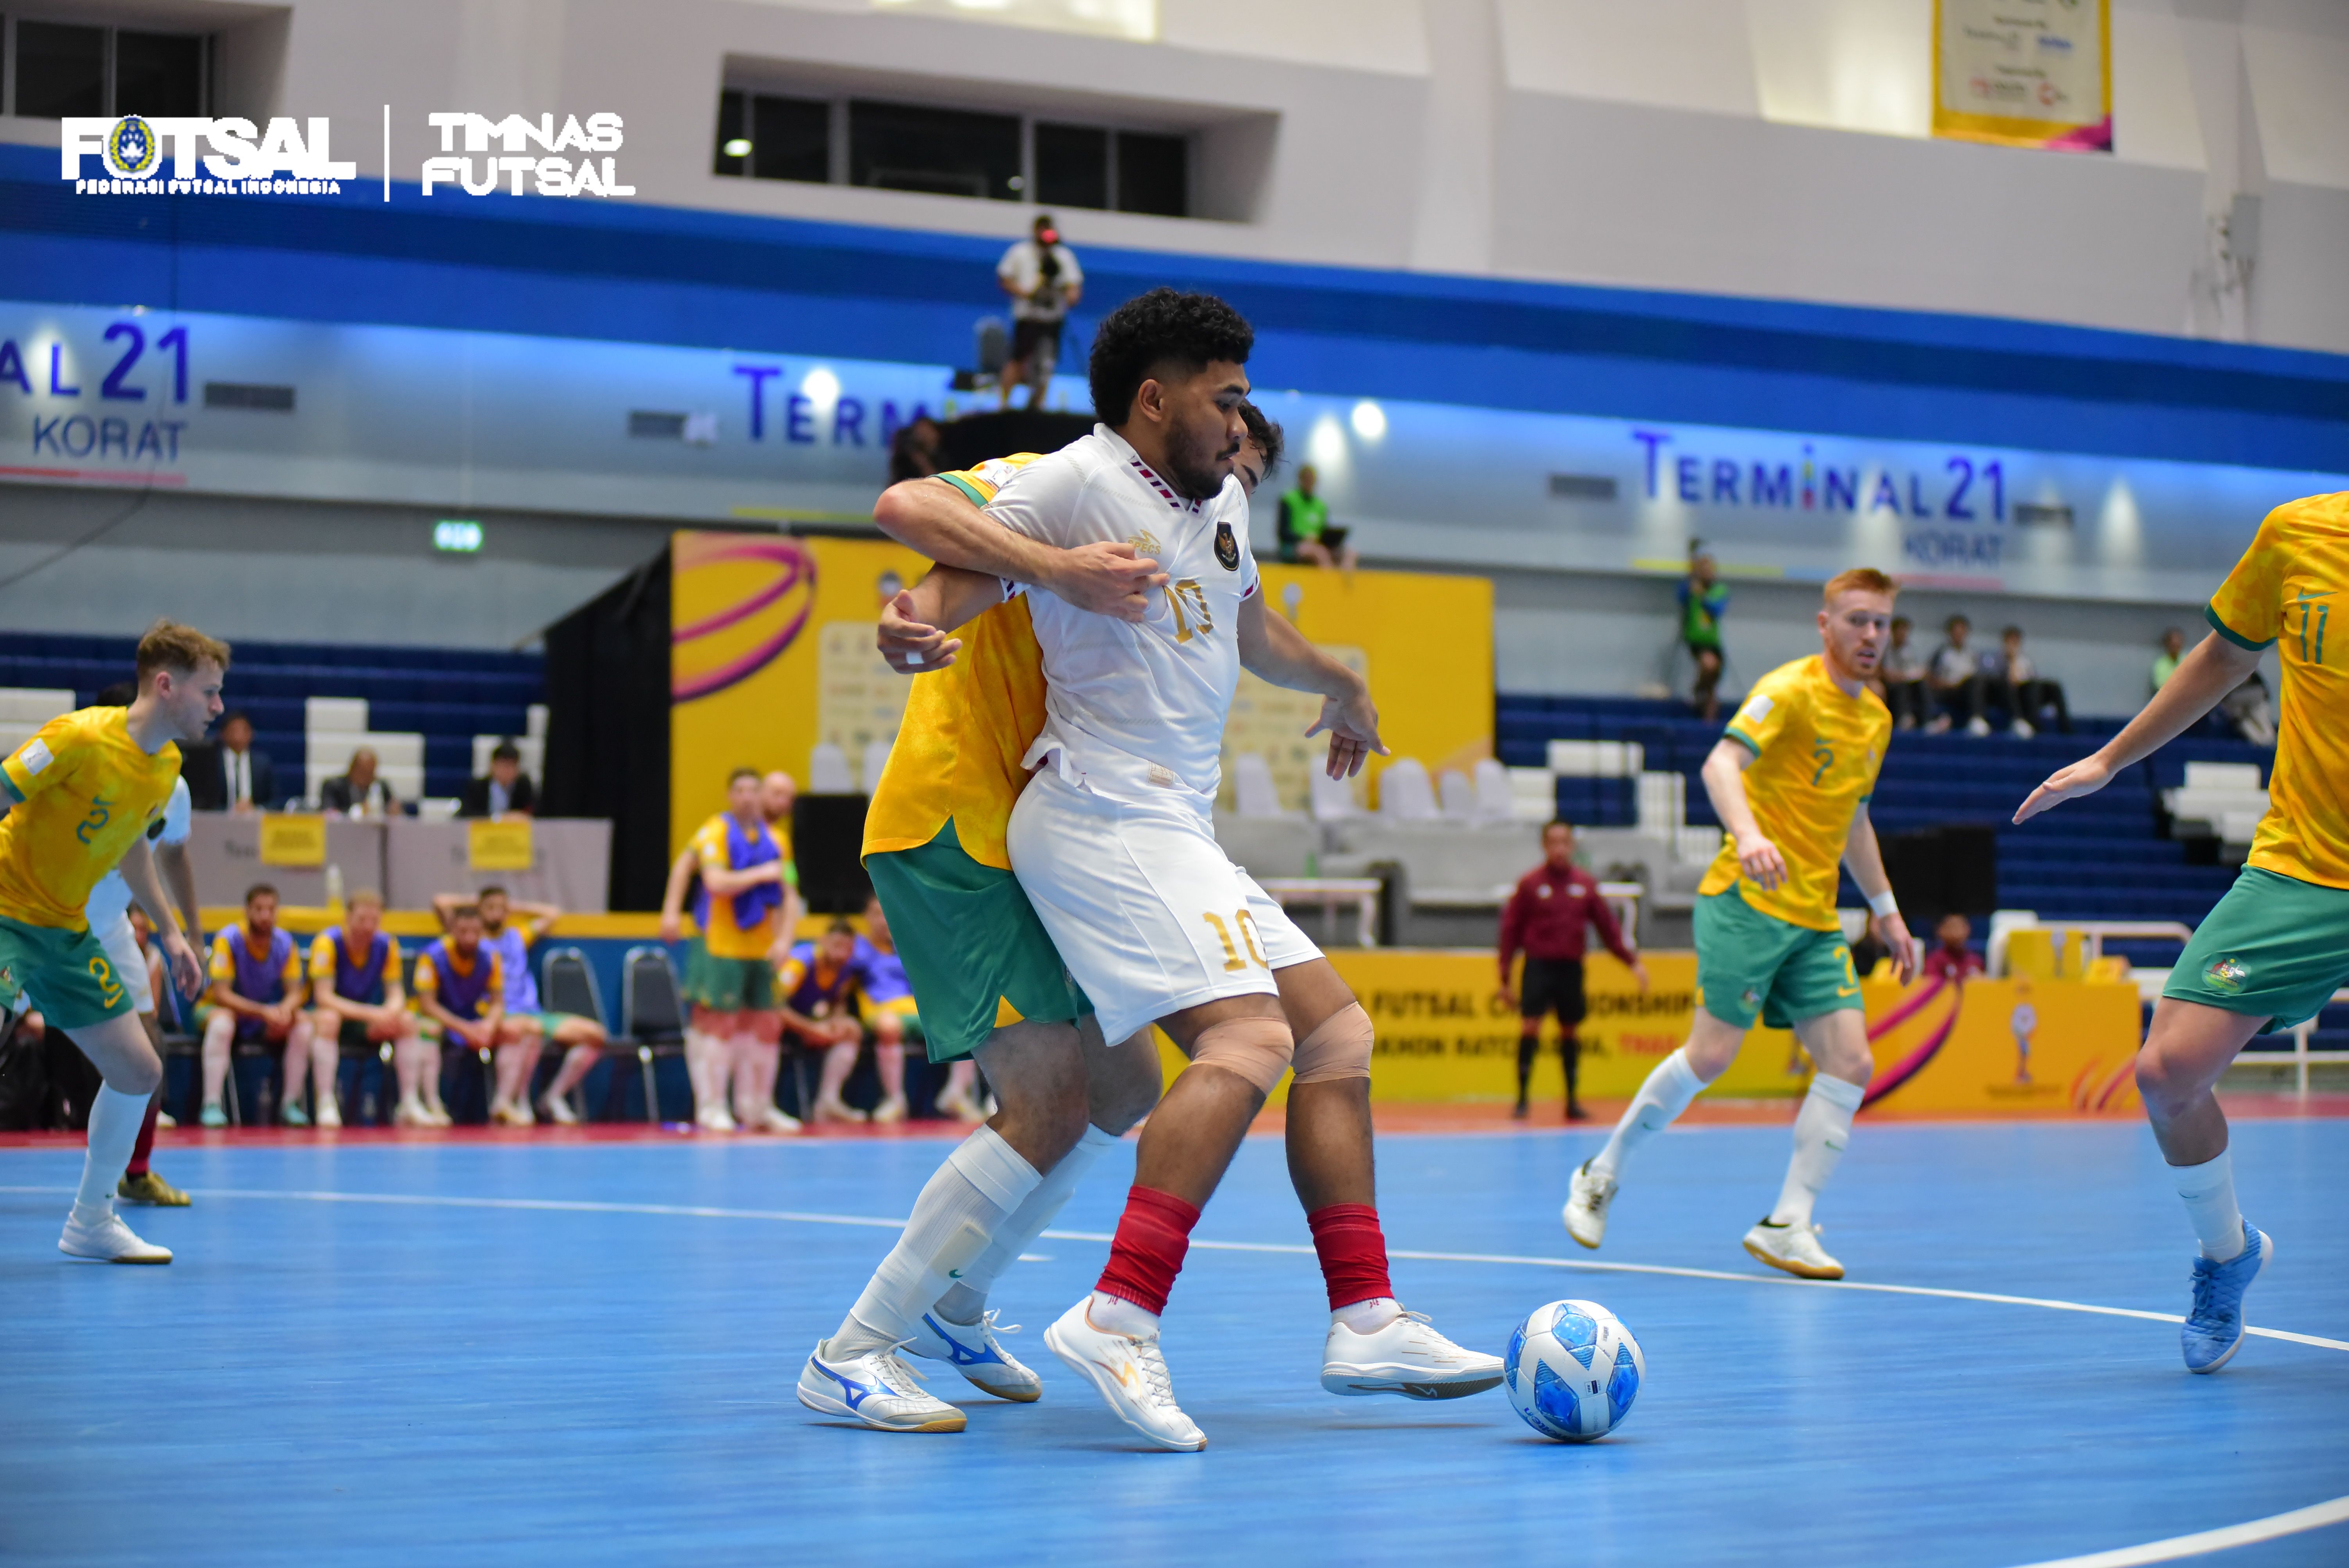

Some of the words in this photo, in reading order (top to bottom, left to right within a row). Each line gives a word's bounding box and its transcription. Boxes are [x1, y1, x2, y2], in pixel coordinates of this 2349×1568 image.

[102, 323, 189, 404] 21
[34, 415, 187, 463] KORAT
[1945, 456, 2005, 522] 21
[1905, 529, 2002, 567] KORAT
[1162, 579, 1214, 644] 10
[2300, 603, 2328, 665] 11
[1812, 748, 1834, 786] 7
[77, 808, 109, 845] 2
[1202, 909, 1269, 971] 10
[89, 957, 120, 993] 2
[1372, 992, 1475, 1018] FUTSAL
